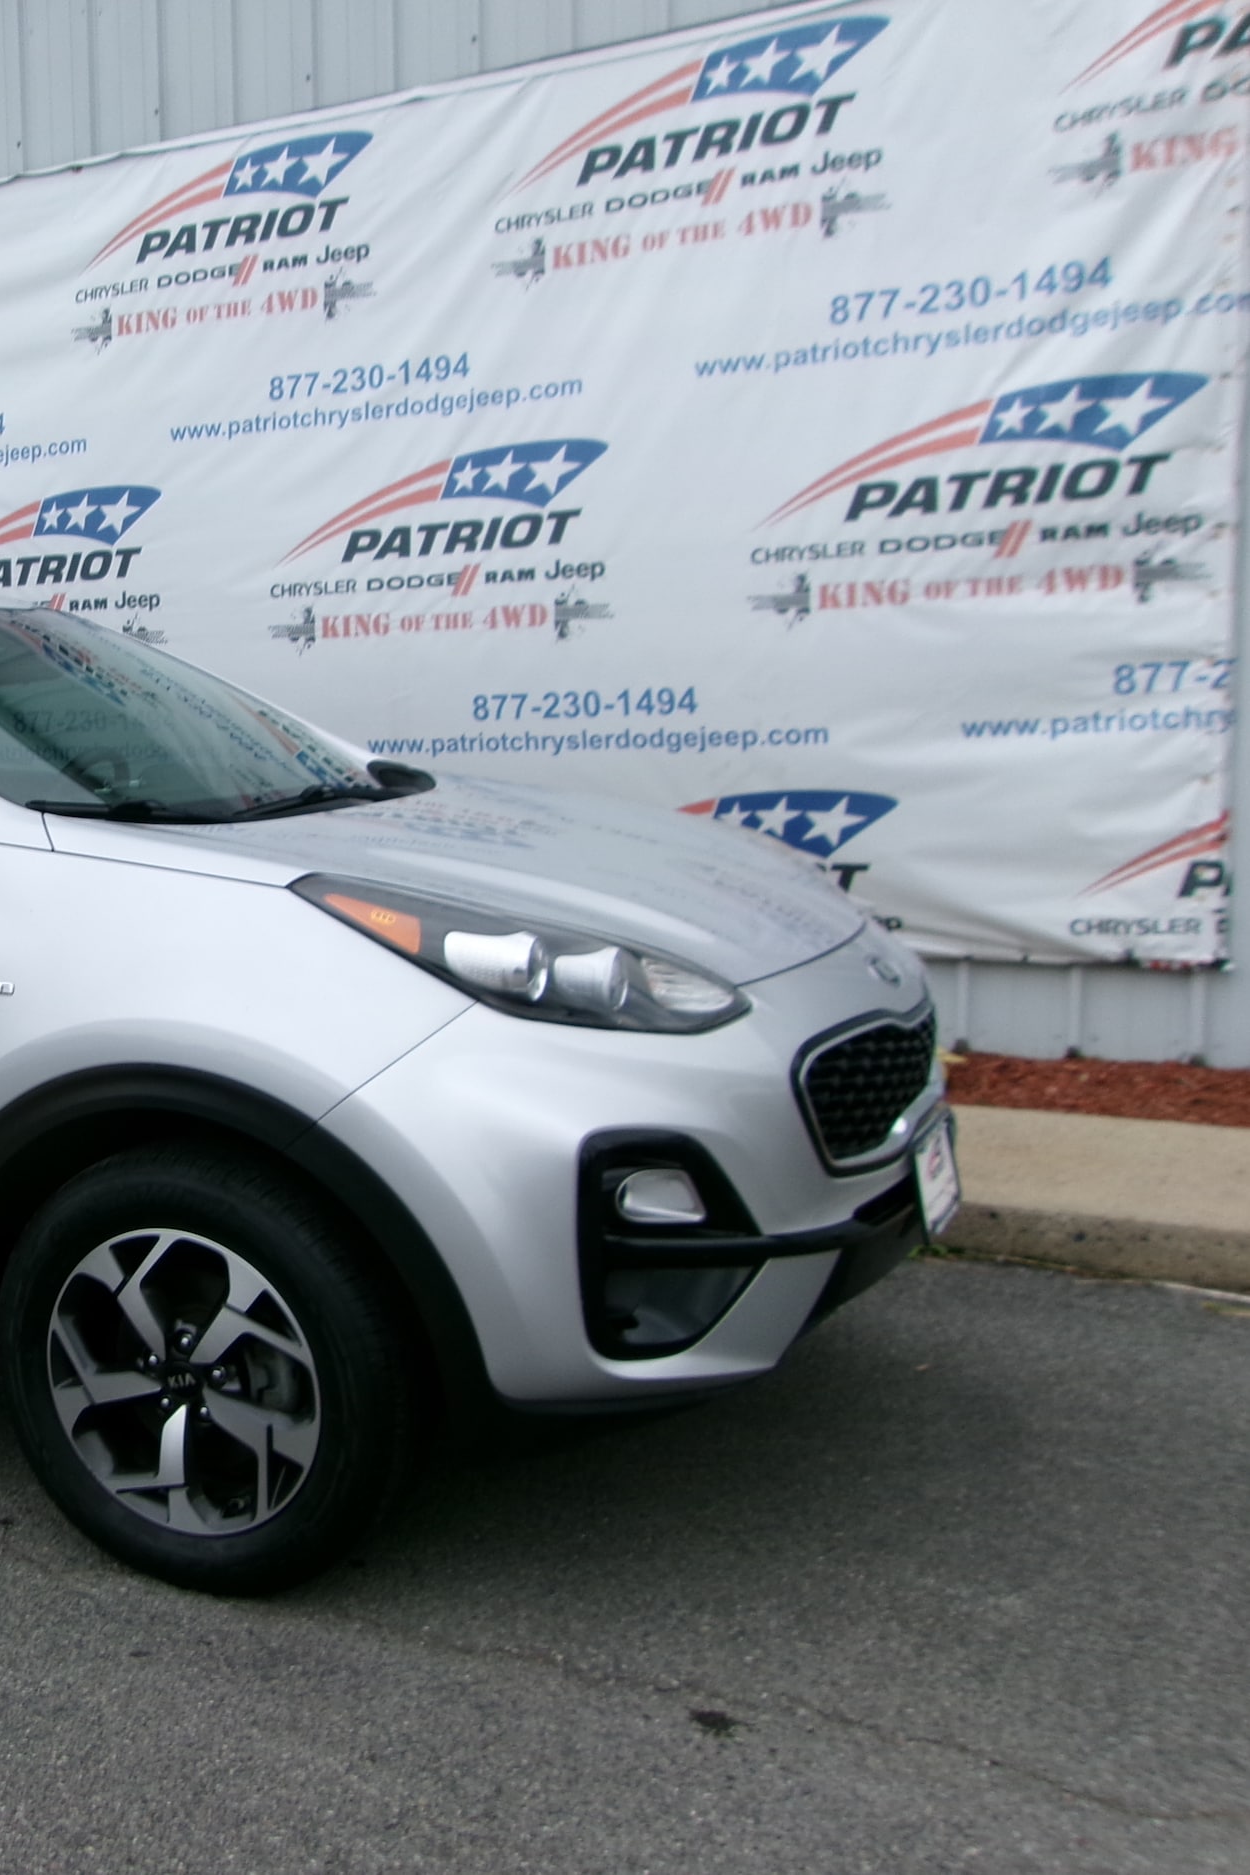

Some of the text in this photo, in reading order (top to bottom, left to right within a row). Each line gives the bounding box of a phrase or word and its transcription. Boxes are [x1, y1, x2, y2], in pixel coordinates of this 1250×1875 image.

[577, 93, 857, 188] PATRIOT
[1130, 124, 1238, 171] KING
[494, 148, 883, 234] CHRYSLER DODGE RAM Jeep
[136, 196, 350, 265] PATRIOT
[553, 201, 812, 270] KING OF THE 4WD
[75, 243, 370, 303] CHRYSLER DODGE RAM Jeep
[831, 256, 1112, 327] 877-230-1494
[117, 287, 318, 336] KING OF THE 4WD
[269, 352, 470, 400] 877-230-1494
[170, 378, 583, 442] www.patriotchryslerdodgejeep.com
[844, 451, 1173, 525] PATRIOT
[341, 507, 582, 564] PATRIOT
[750, 511, 1204, 567] CHRYSLER DODGE RAM Jeep
[69, 598, 108, 612] RAM
[114, 591, 161, 611] Jeep
[270, 559, 606, 599] CHRYSLER DODGE RAM Jeep
[818, 564, 1124, 611] KING OF THE 4WD
[321, 603, 548, 640] KING OF THE 4WD
[472, 686, 698, 722] 877-230-1494
[367, 723, 829, 757] www.patriotchryslerdodgejeep.com
[1069, 916, 1202, 937] CHRYSLER
[167, 1372, 196, 1389] KIA
